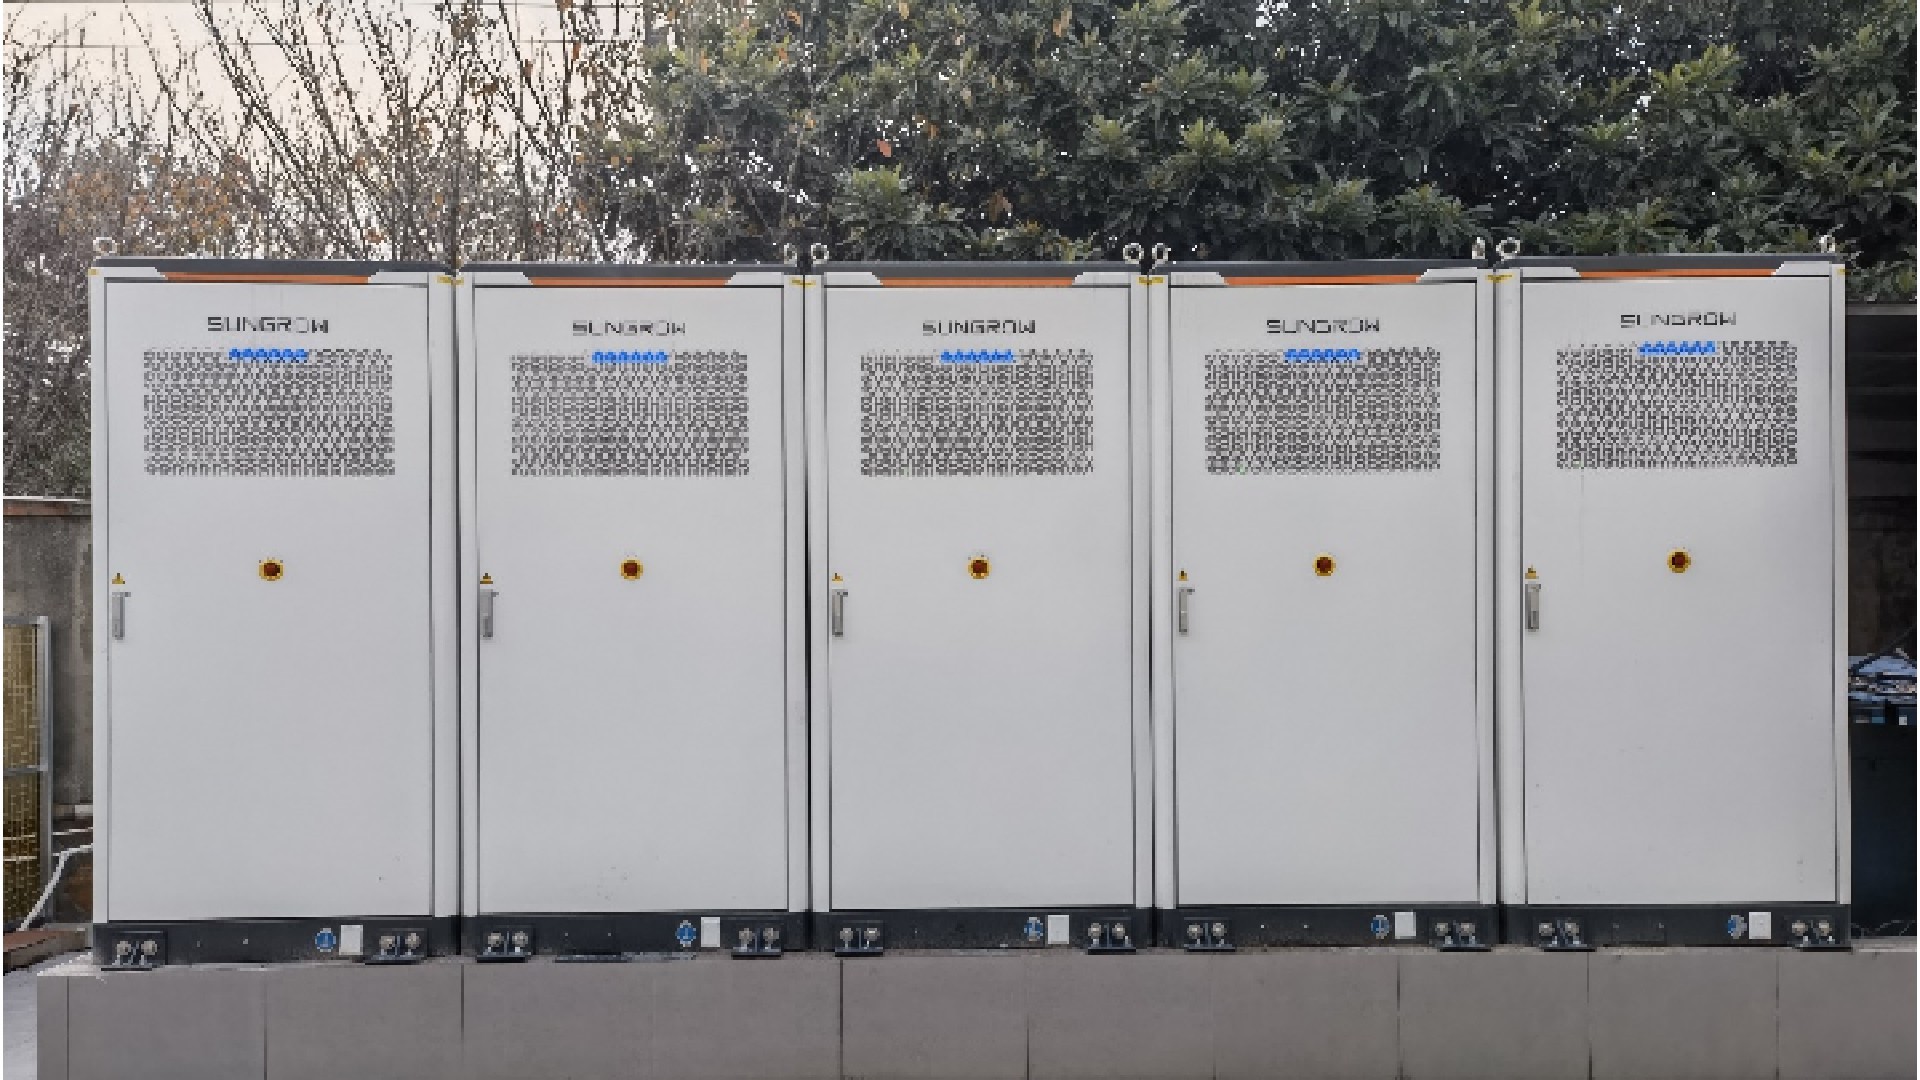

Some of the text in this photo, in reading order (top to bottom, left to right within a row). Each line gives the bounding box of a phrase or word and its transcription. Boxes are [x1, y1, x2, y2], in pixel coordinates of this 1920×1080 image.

[207, 316, 329, 333] SUNGROW
[572, 319, 686, 337] SUNGROW
[922, 319, 1036, 336] SUNGROW
